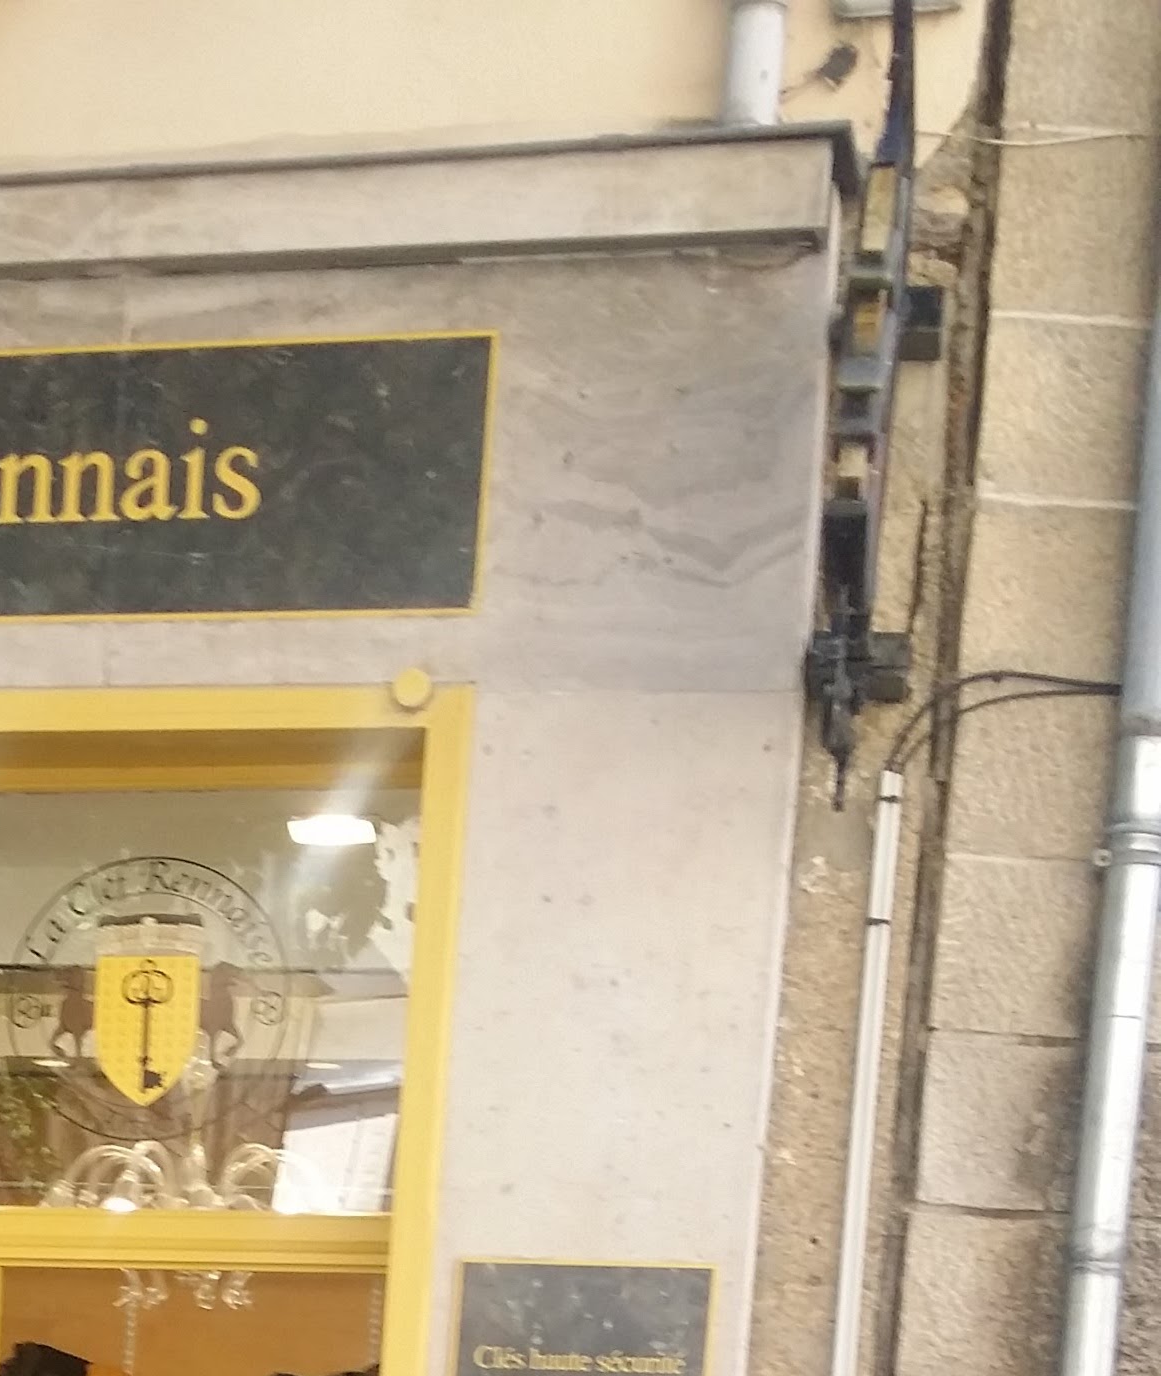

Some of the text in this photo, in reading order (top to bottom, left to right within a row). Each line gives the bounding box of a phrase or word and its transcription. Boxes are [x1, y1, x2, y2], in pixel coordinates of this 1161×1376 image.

[473, 1345, 688, 1375] Clés haute sécurité
